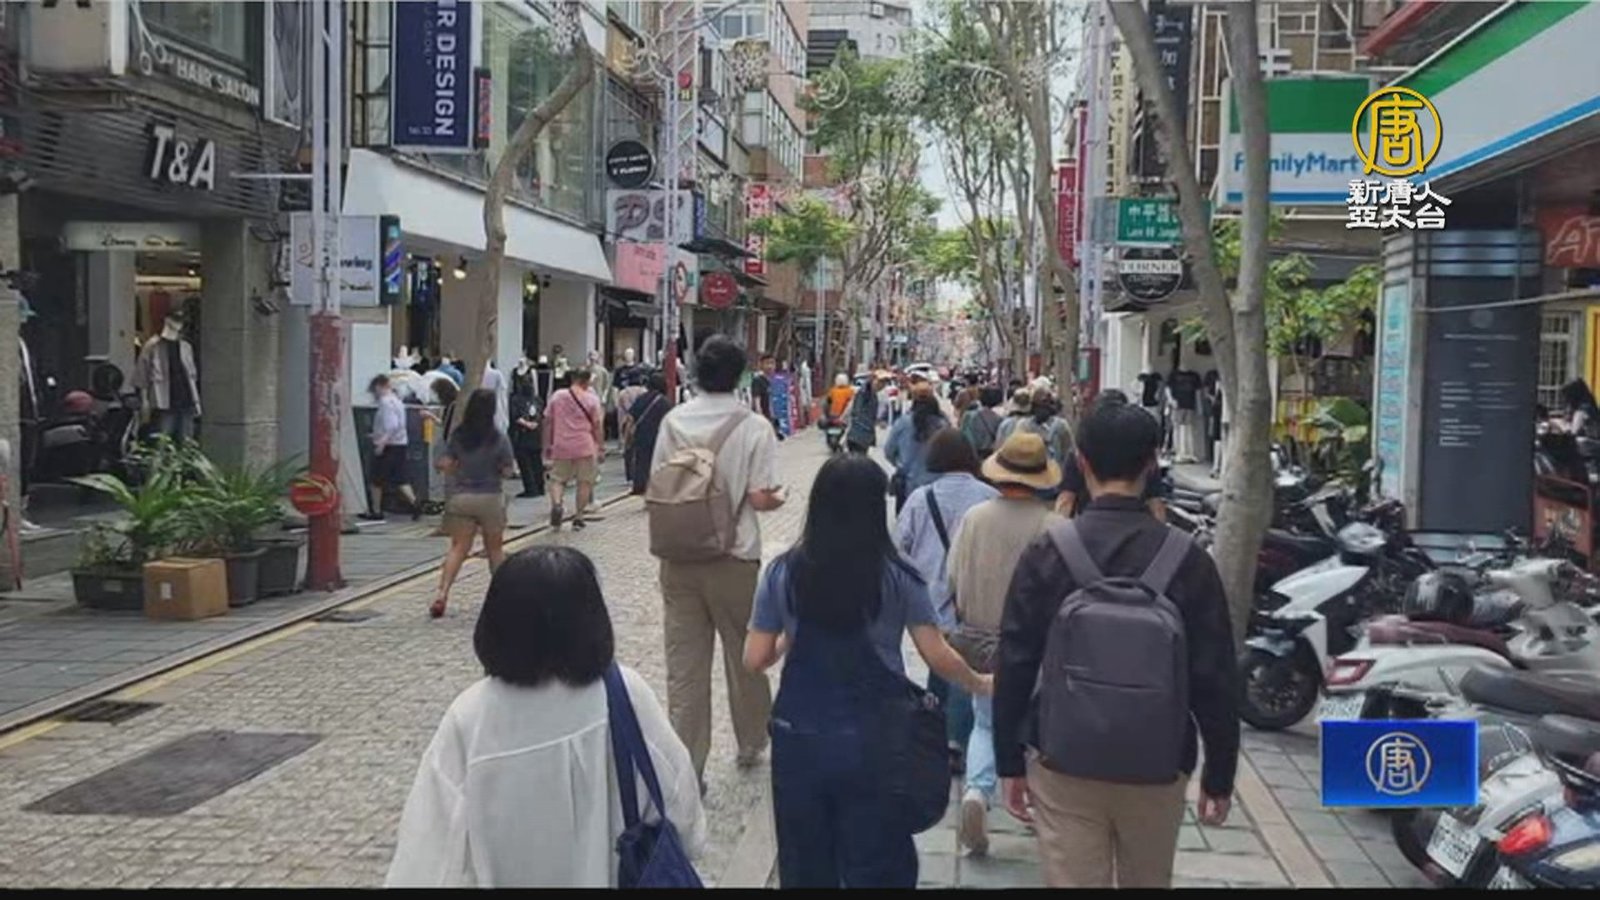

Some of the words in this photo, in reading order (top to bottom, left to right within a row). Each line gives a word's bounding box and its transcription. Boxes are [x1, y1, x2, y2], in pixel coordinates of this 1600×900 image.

[177, 57, 214, 88] HAIR
[215, 74, 260, 105] SALON
[434, 35, 456, 135] DESIGN
[150, 126, 215, 190] T&A
